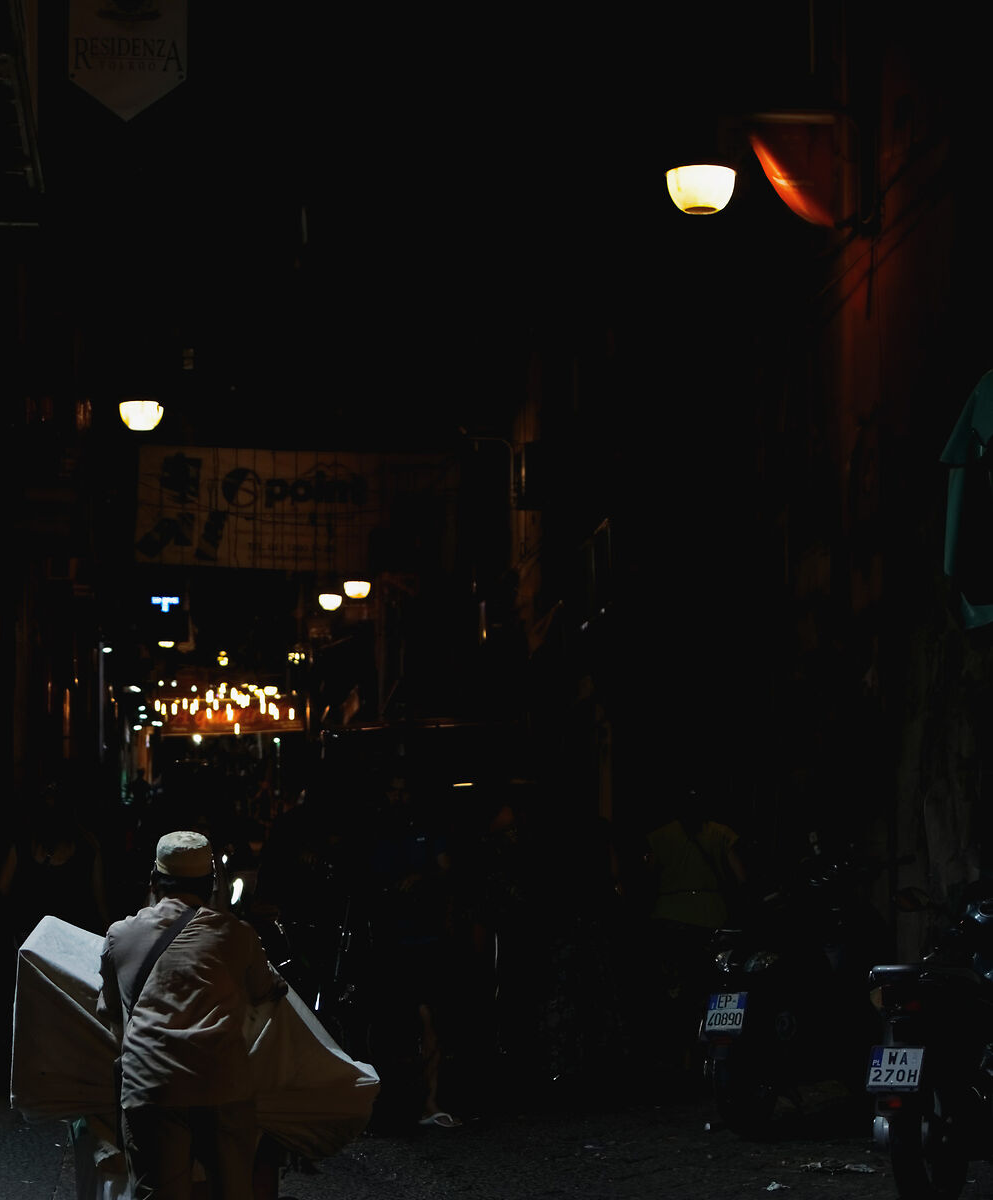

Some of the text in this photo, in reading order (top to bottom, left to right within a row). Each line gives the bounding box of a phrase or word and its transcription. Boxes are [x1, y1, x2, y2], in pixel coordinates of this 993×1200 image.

[74, 37, 183, 71] RESIDENZA
[888, 1051, 908, 1065] WA
[872, 1069, 918, 1083] 270H
